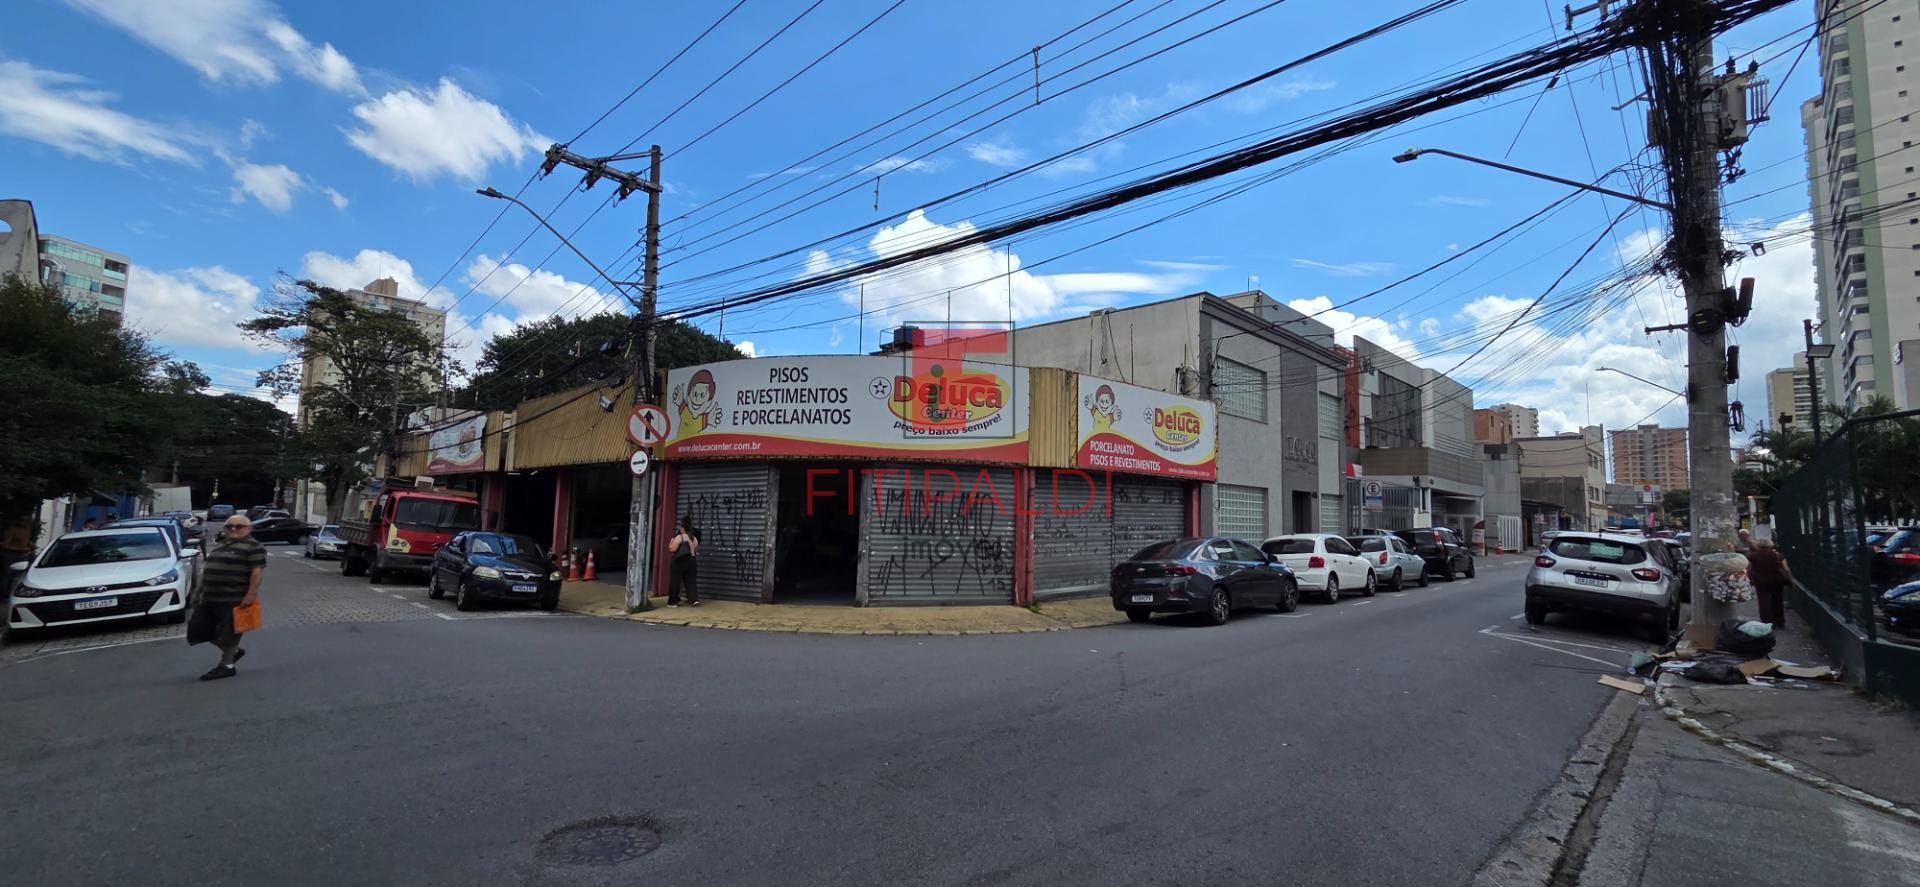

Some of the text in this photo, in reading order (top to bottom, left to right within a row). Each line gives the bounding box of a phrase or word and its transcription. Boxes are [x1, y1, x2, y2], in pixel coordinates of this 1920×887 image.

[769, 366, 809, 383] PISOS
[737, 387, 848, 405] REVESTIMENTOS
[894, 375, 1002, 408] Deluca
[732, 408, 851, 425] E PORCELANATOS
[893, 420, 925, 435] preço
[962, 413, 1002, 433] sempre!
[1155, 407, 1200, 435] Deluca
[678, 441, 761, 453] www.delucacenter.com.br
[1090, 440, 1135, 455] PORCELANATO
[1090, 454, 1161, 472] PISOS E REVESTIMENTOS
